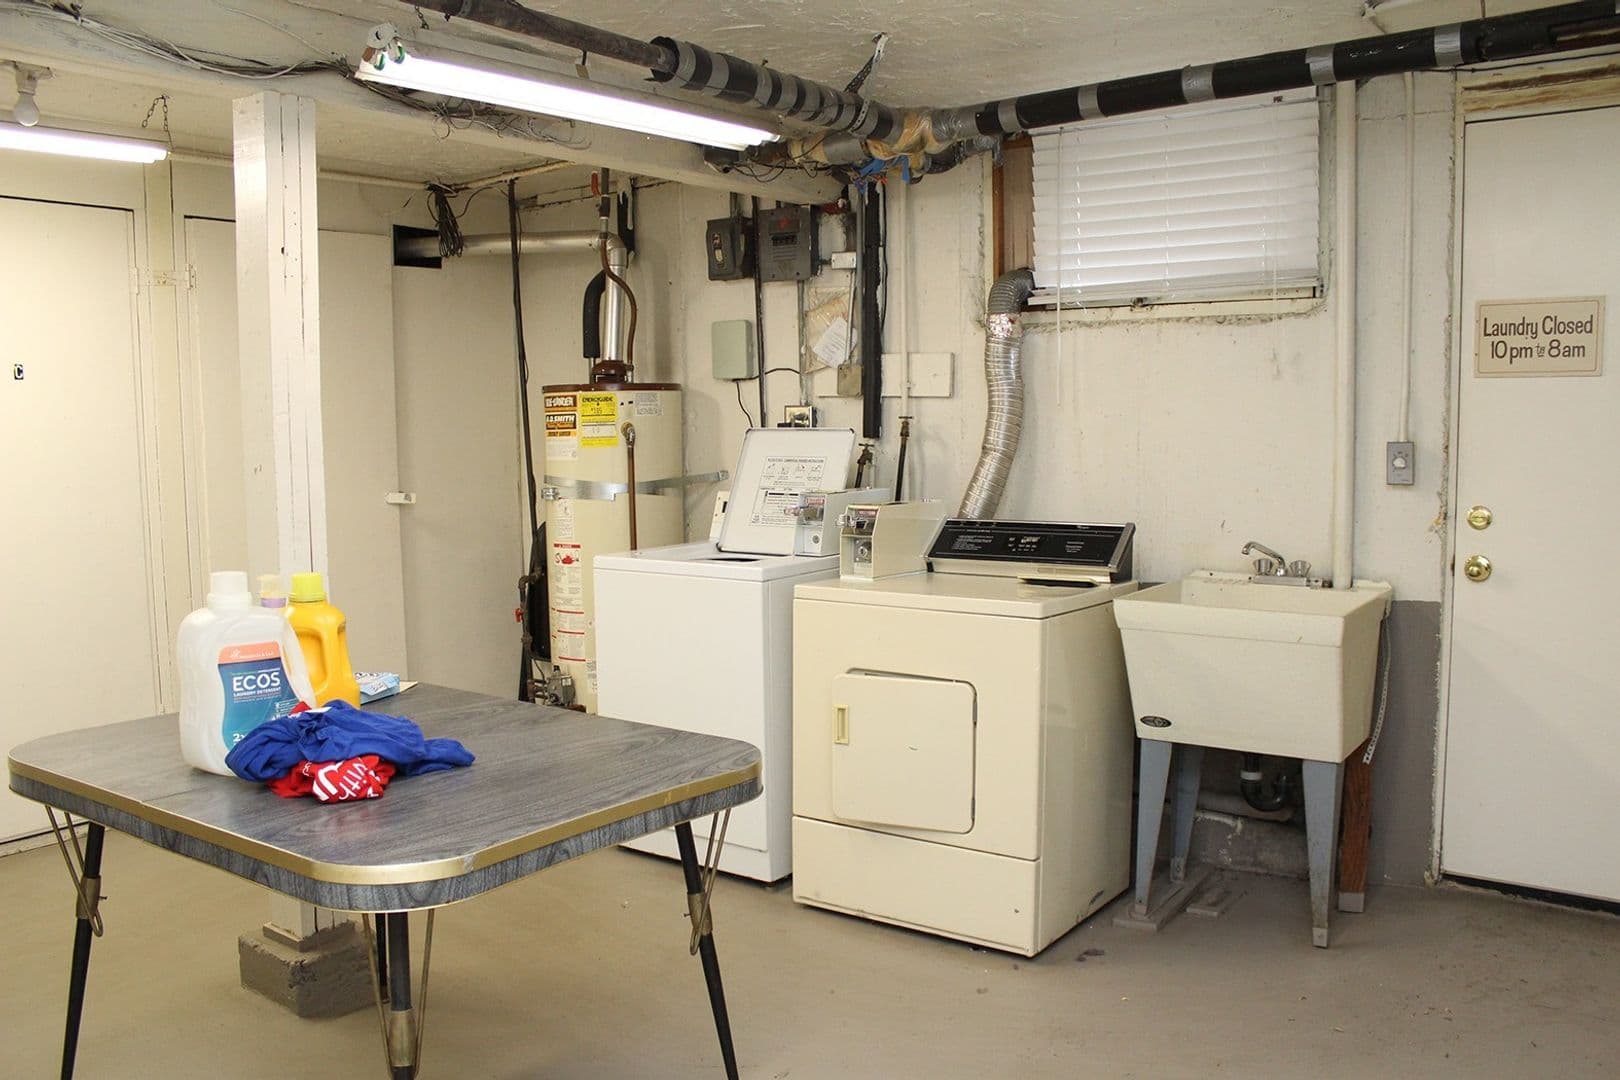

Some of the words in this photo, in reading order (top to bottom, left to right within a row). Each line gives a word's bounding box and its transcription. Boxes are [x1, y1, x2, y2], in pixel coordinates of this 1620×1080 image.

[1483, 316, 1538, 340] Laundry
[1542, 314, 1594, 336] Closed
[232, 671, 280, 692] ECOS
[256, 687, 281, 695] DETERGENT
